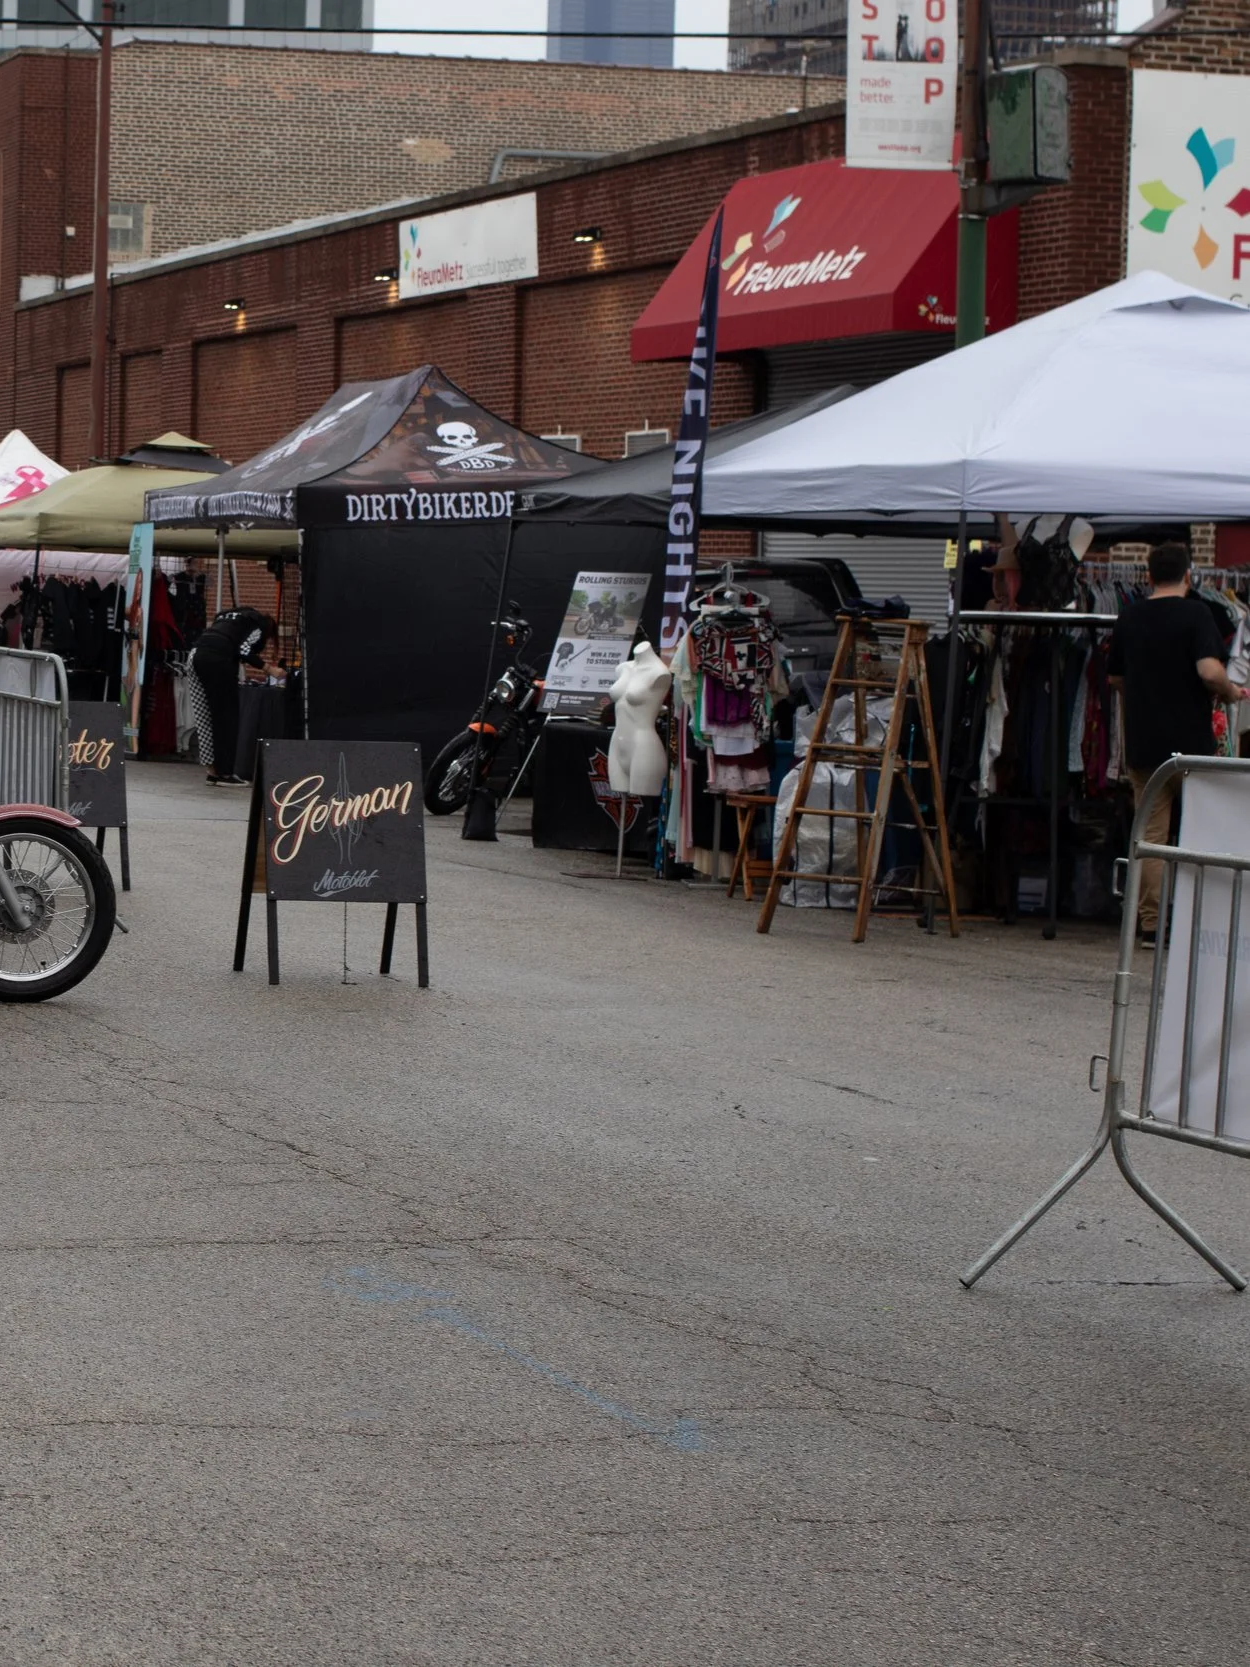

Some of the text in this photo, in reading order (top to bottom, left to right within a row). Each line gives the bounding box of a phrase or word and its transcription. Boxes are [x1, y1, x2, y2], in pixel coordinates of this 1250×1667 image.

[860, 77, 892, 89] made
[417, 261, 464, 288] FleuraMetz
[733, 245, 867, 296] FleuraMetz
[459, 457, 496, 469] DBD
[660, 440, 701, 649] NIGHTS
[578, 576, 649, 585] ROLLING STURGIS
[271, 775, 413, 865] German
[313, 869, 379, 896] Motoblot
